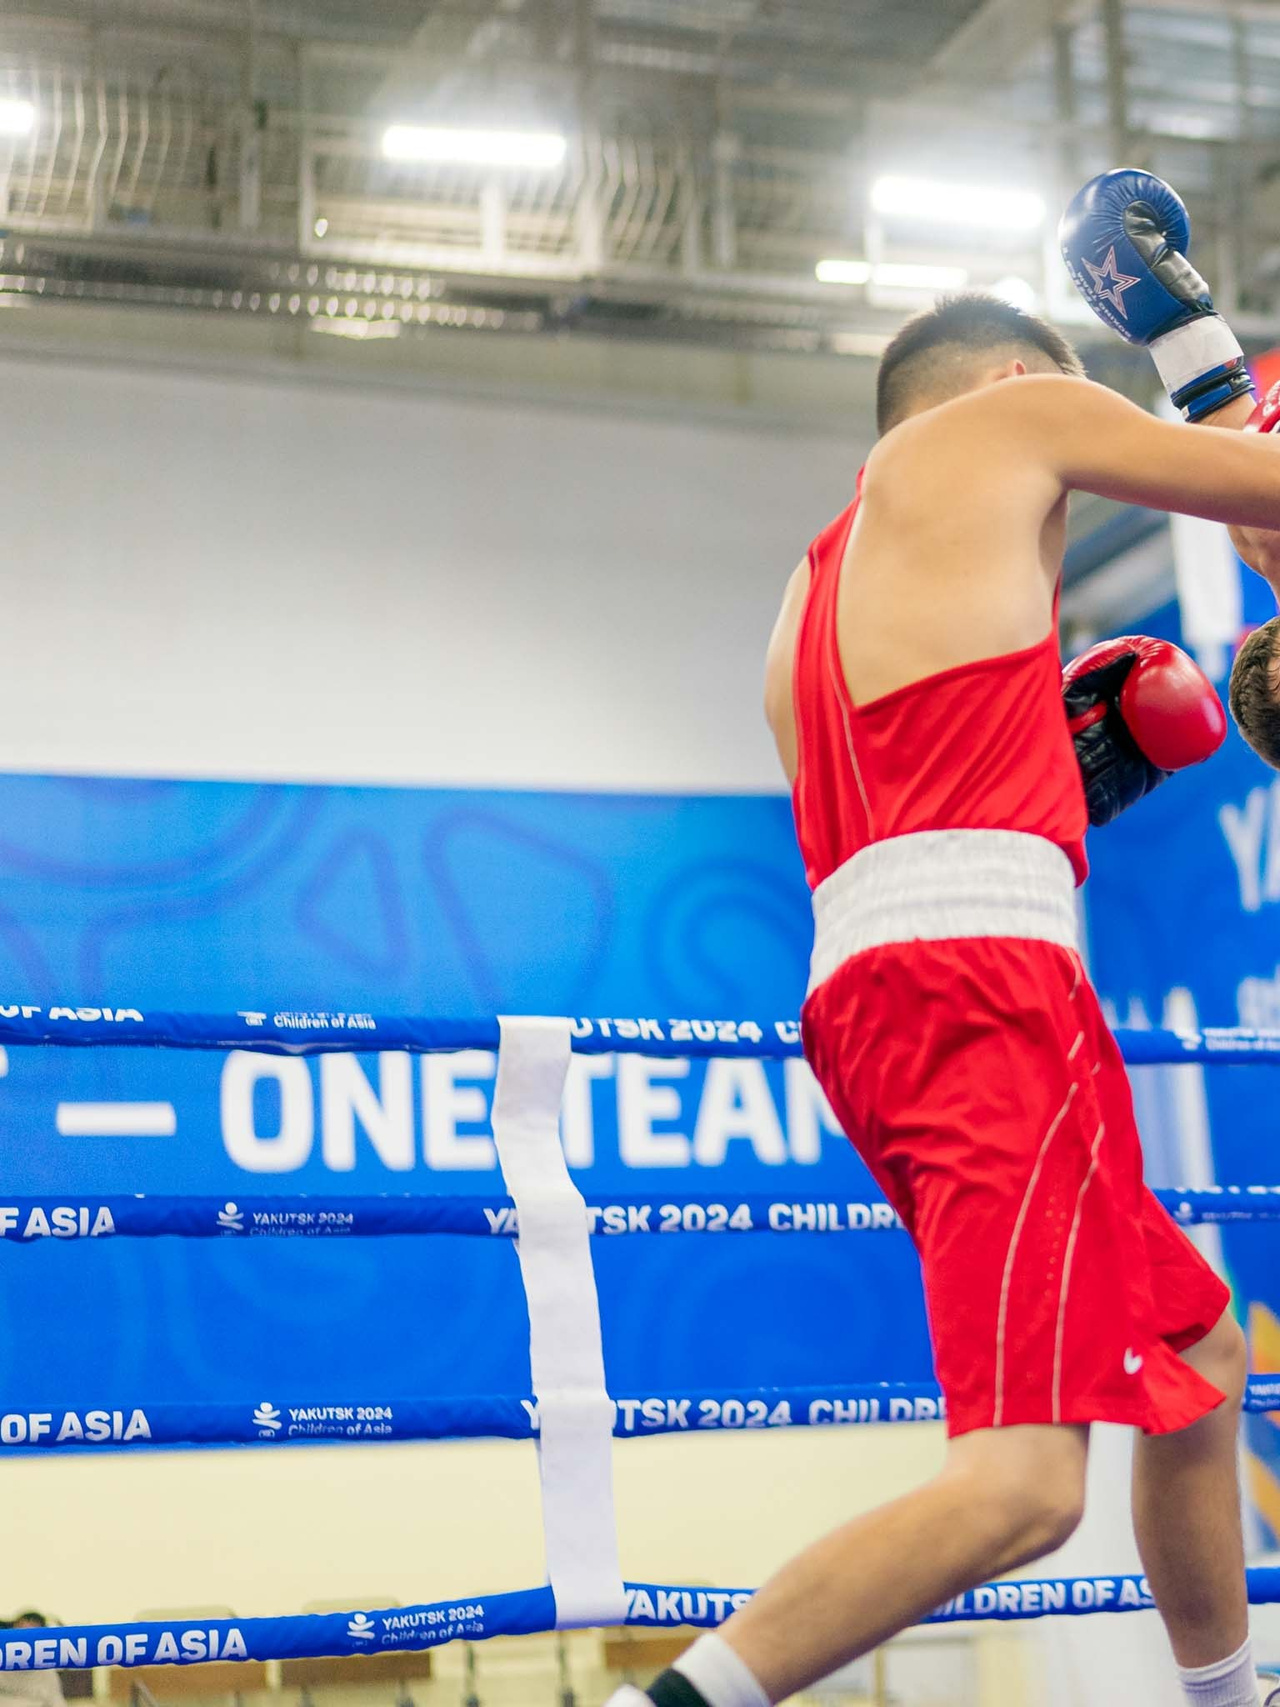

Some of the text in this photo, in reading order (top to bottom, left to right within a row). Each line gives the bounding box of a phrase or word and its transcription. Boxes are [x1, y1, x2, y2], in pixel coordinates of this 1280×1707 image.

[220, 1050, 497, 1174] ONE
[22, 1206, 116, 1238] ASIA
[252, 1212, 316, 1226] YAKUTSK
[660, 1205, 752, 1230] 2024
[1, 1410, 150, 1442] OF ASIA
[288, 1406, 393, 1422] YAKUTSK 2024
[700, 1400, 792, 1430] 2024
[622, 1590, 752, 1624] YAKUTS
[1070, 1579, 1114, 1610] OF
[382, 1604, 485, 1631] YAKUTSK 2024
[96, 1634, 148, 1667] OF
[156, 1628, 248, 1664] ASIA
